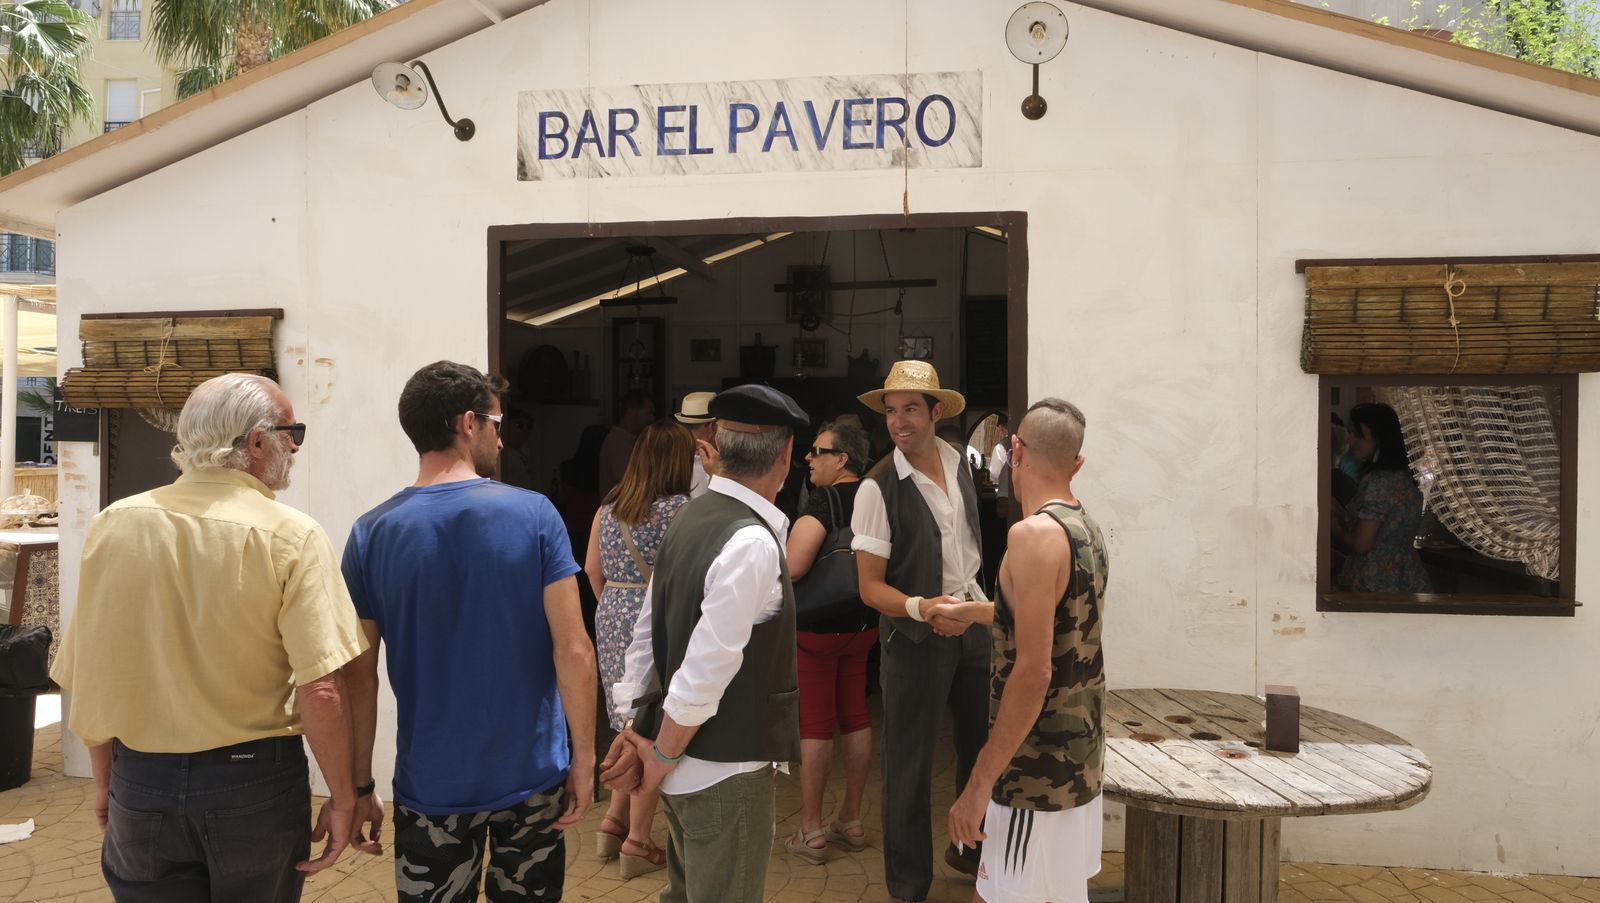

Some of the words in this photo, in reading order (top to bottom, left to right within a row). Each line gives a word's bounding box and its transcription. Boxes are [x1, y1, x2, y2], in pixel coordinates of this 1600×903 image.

[538, 109, 641, 160] BAR
[657, 104, 713, 156] EL
[727, 94, 957, 154] PAVERO
